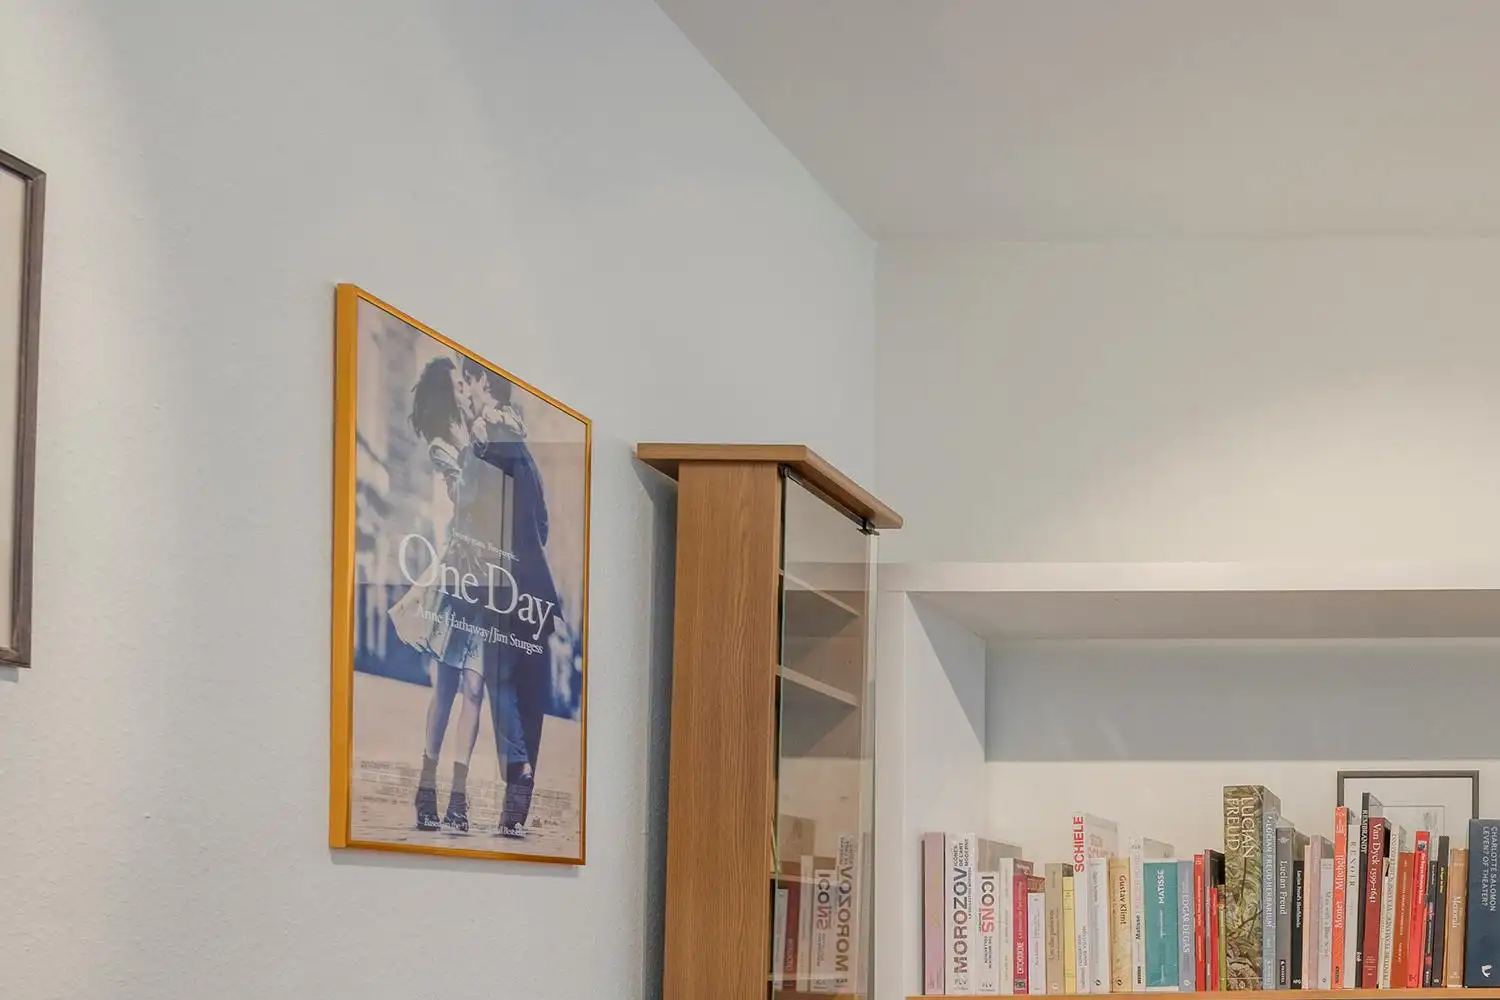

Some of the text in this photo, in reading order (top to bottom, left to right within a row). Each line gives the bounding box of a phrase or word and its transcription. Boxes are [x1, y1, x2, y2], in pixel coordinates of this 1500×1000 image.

[399, 534, 480, 604] One
[485, 563, 555, 641] Day
[510, 633, 544, 654] Sturgess
[1072, 816, 1085, 872] SCHIELE
[1226, 798, 1240, 851] FREUD
[1240, 797, 1255, 859] LUCIAN
[1371, 823, 1380, 840] Van
[1348, 841, 1357, 888] RENOIR
[1371, 842, 1381, 865] Dyck
[1482, 856, 1489, 868] OF
[1489, 826, 1498, 911] CHARLOTTE SALOMON
[982, 876, 995, 933] ICONS
[1118, 875, 1127, 925] Gustav Klimt
[1279, 860, 1287, 916] Lucian Freud
[1334, 855, 1344, 929] Monet Mitchell
[1481, 870, 1489, 907] THEATER?
[953, 866, 969, 974] MOROZOV
